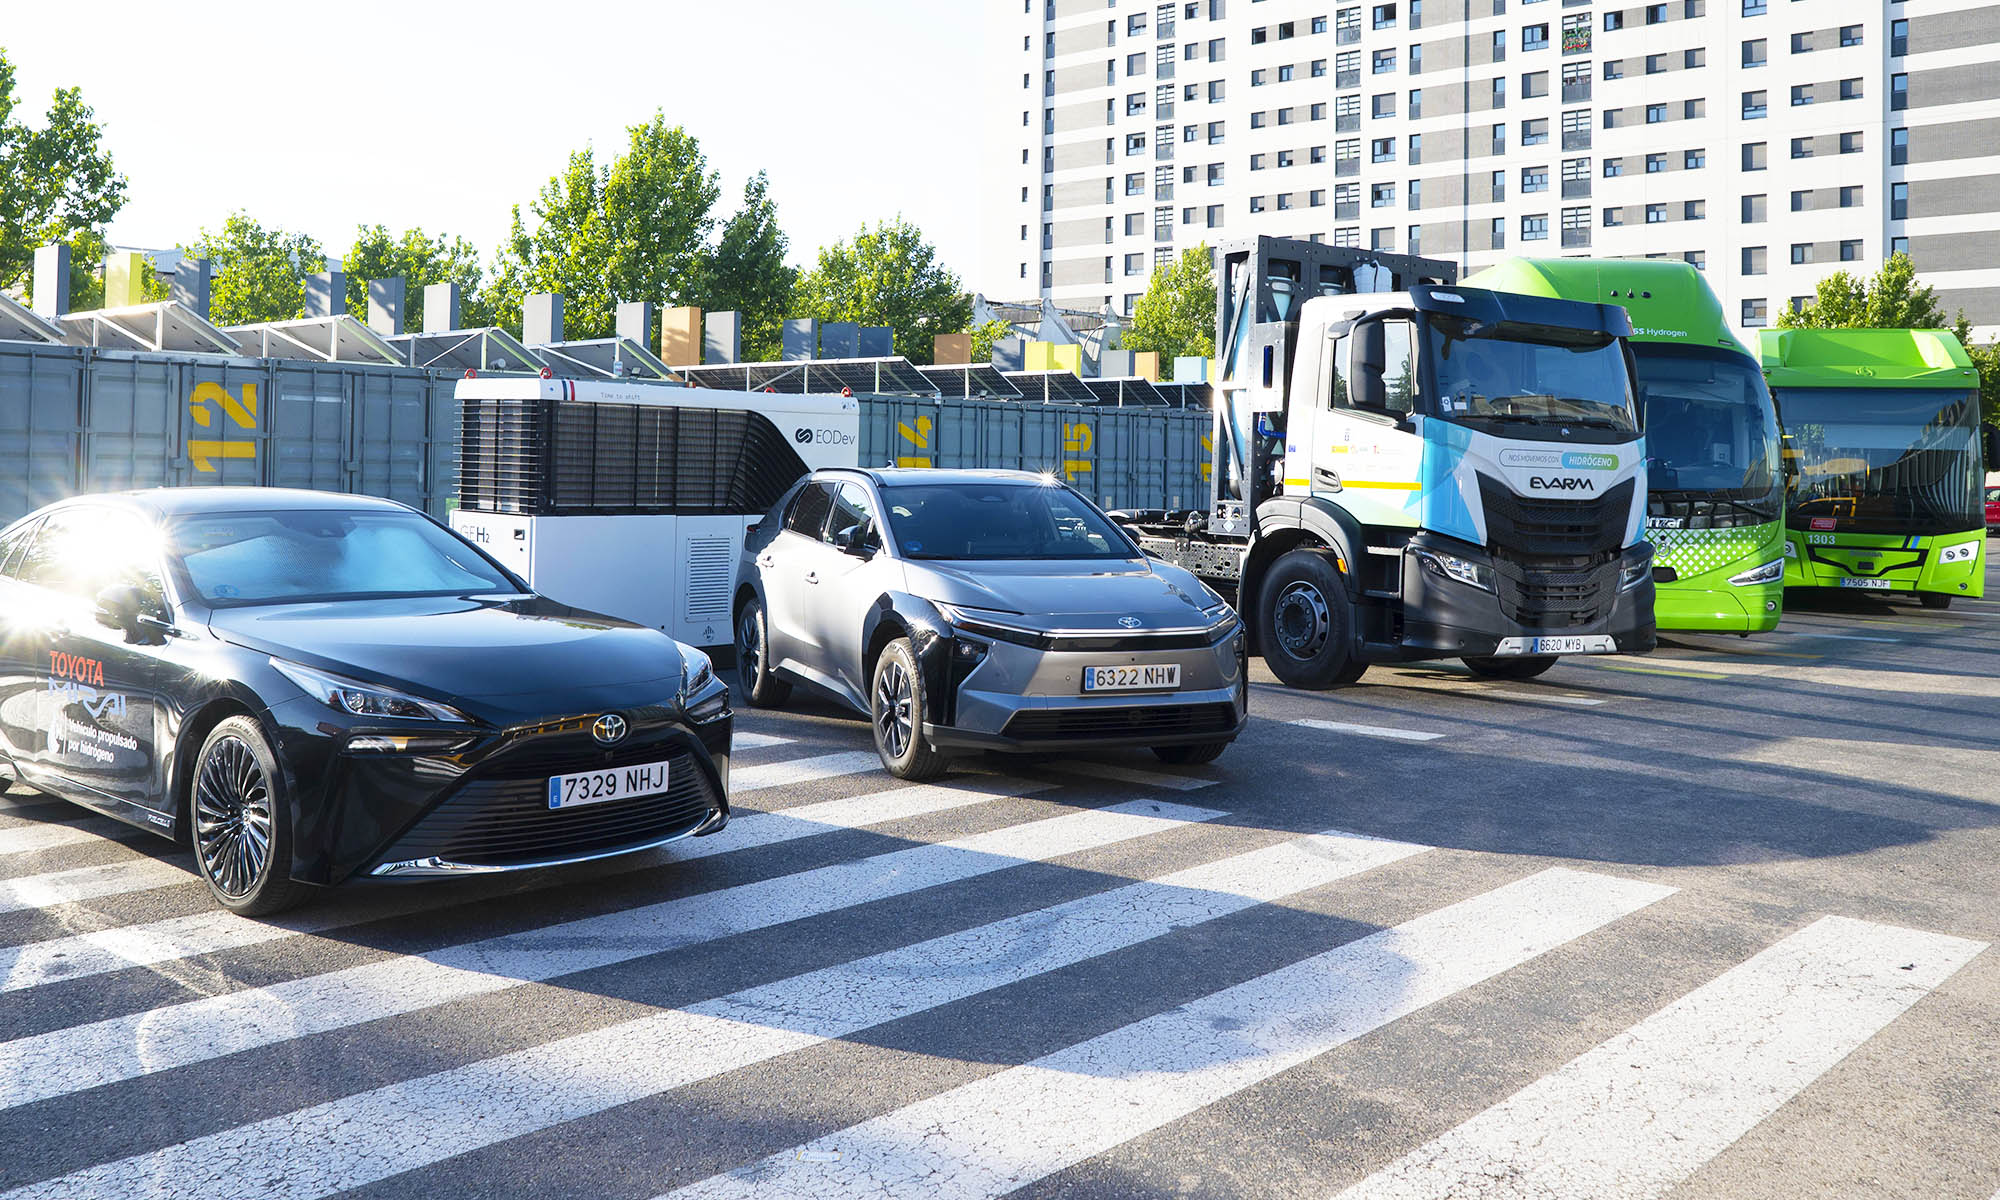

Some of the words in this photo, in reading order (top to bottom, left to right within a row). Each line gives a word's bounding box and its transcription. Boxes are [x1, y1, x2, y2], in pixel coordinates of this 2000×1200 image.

[1646, 328, 1688, 338] Hydrogen
[187, 382, 258, 472] 12
[816, 429, 855, 445] EODev
[1064, 424, 1092, 481] 15
[1508, 454, 1520, 462] NOS
[1520, 455, 1547, 463] MOVEMOS
[1547, 456, 1560, 464] CON
[1568, 454, 1613, 467] HIDRÓGENO
[1529, 476, 1595, 491] EVARM
[1808, 534, 1836, 545] 1303
[1871, 579, 1889, 588] NJF
[1540, 639, 1561, 651] 6620
[1565, 638, 1581, 651] MYB
[49, 650, 105, 687] TOYOTA
[1096, 669, 1139, 686] 6322
[1144, 667, 1176, 685] NHW
[68, 718, 98, 739] Vehículo
[97, 730, 138, 750] propulsado
[67, 740, 80, 753] por
[80, 741, 115, 763] hidrógeno
[565, 773, 617, 803] 7329
[626, 766, 664, 793] NHJ
